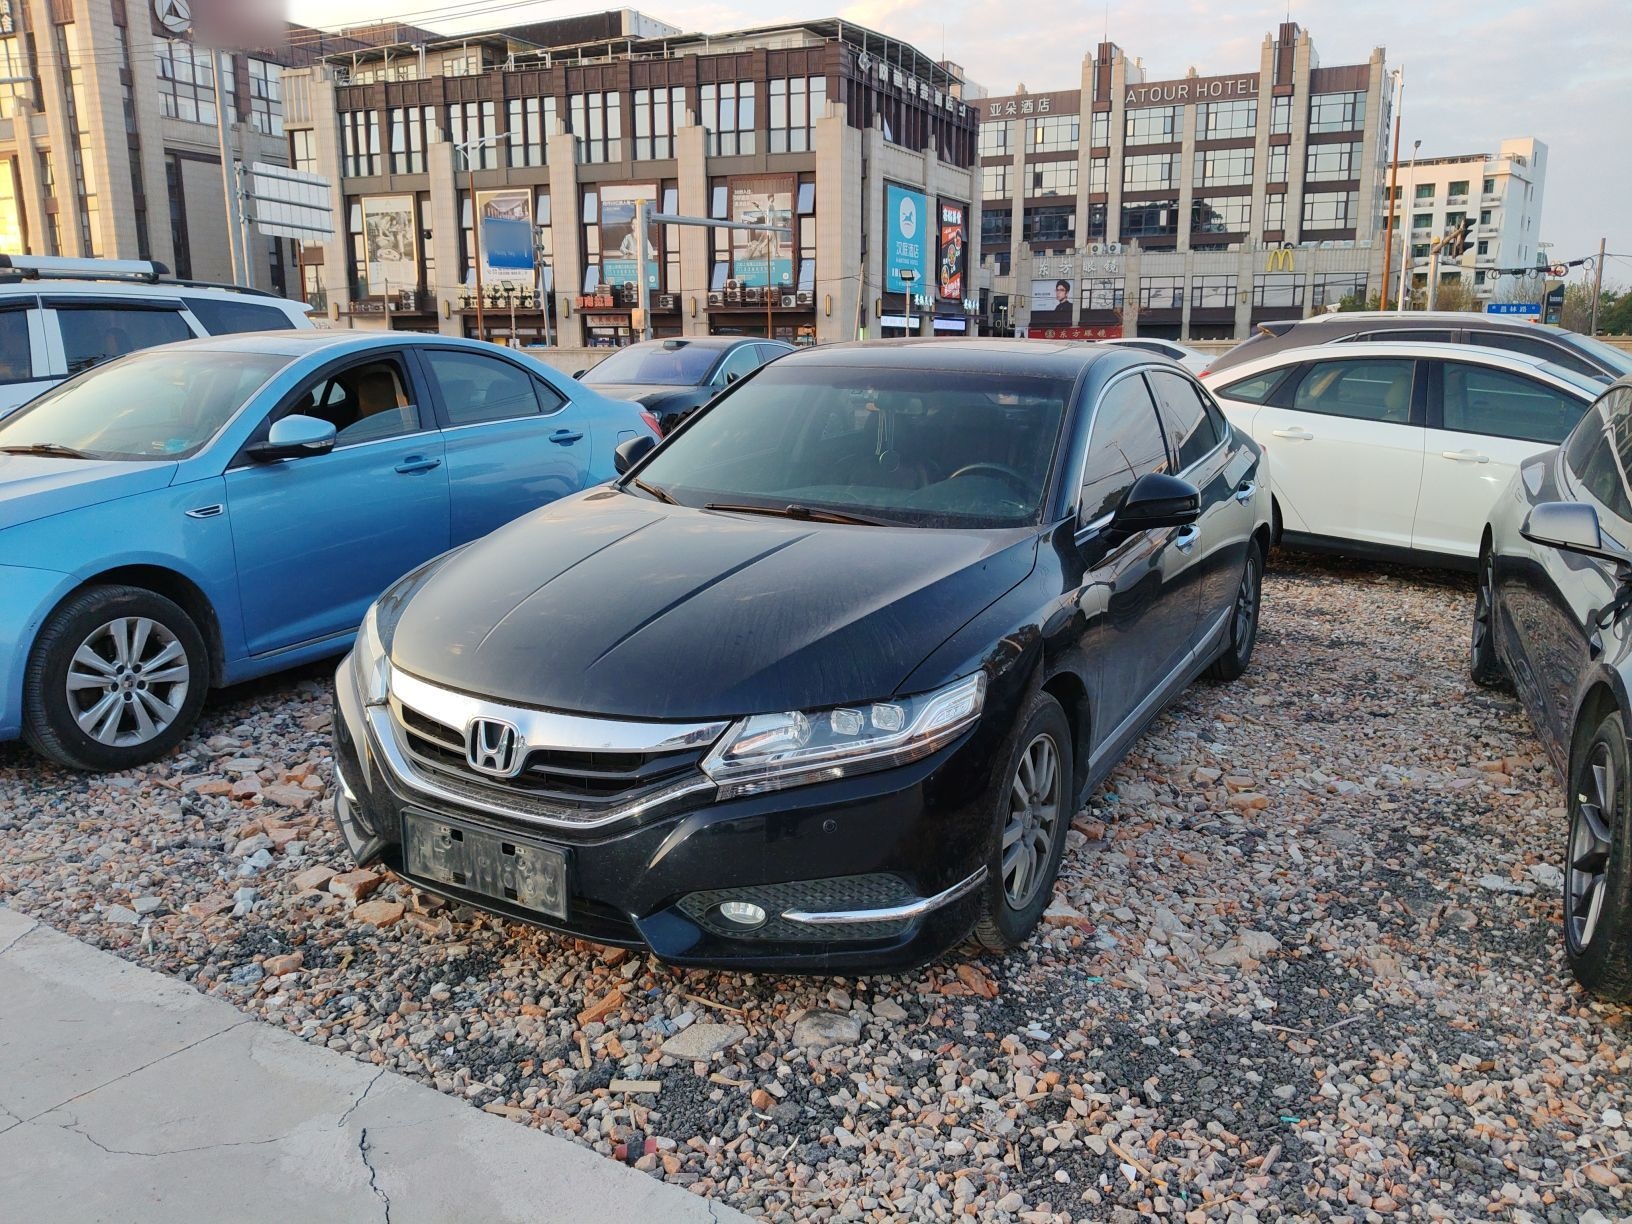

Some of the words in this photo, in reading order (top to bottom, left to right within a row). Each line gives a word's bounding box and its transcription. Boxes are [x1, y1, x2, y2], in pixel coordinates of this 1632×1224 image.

[1125, 84, 1189, 104] ATOUR
[1196, 79, 1258, 98] HOTEL
[989, 97, 1051, 117] 亚朵酒店
[1038, 259, 1119, 277] 东方眼镜
[1059, 328, 1107, 338] 东方眼镜
